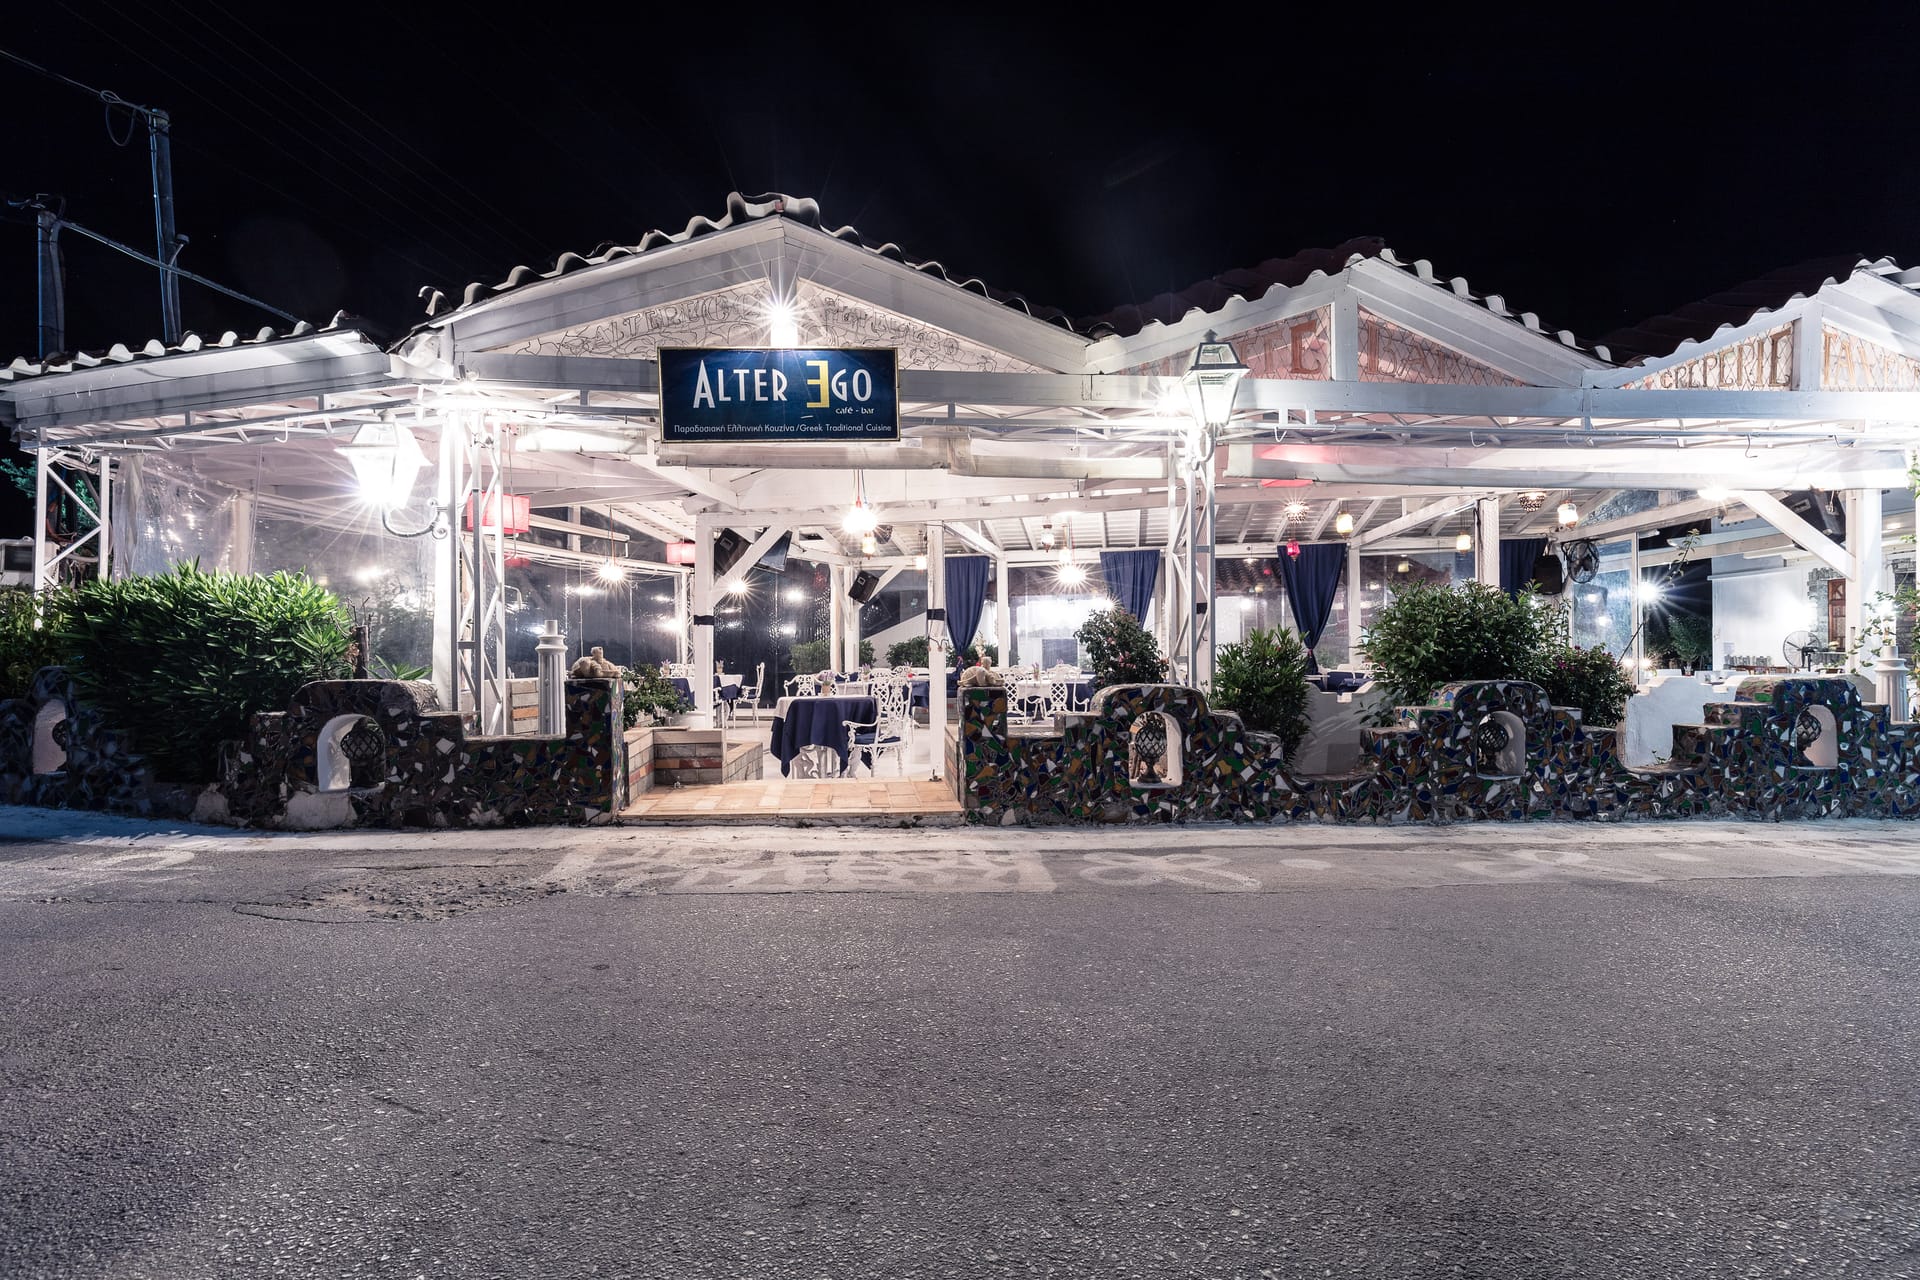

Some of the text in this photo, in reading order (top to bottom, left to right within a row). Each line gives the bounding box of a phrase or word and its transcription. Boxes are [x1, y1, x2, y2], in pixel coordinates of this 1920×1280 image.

[693, 359, 872, 409] ALTER EGO
[861, 406, 875, 415] bar
[825, 423, 863, 433] Traditional
[865, 423, 892, 433] Cuisine
